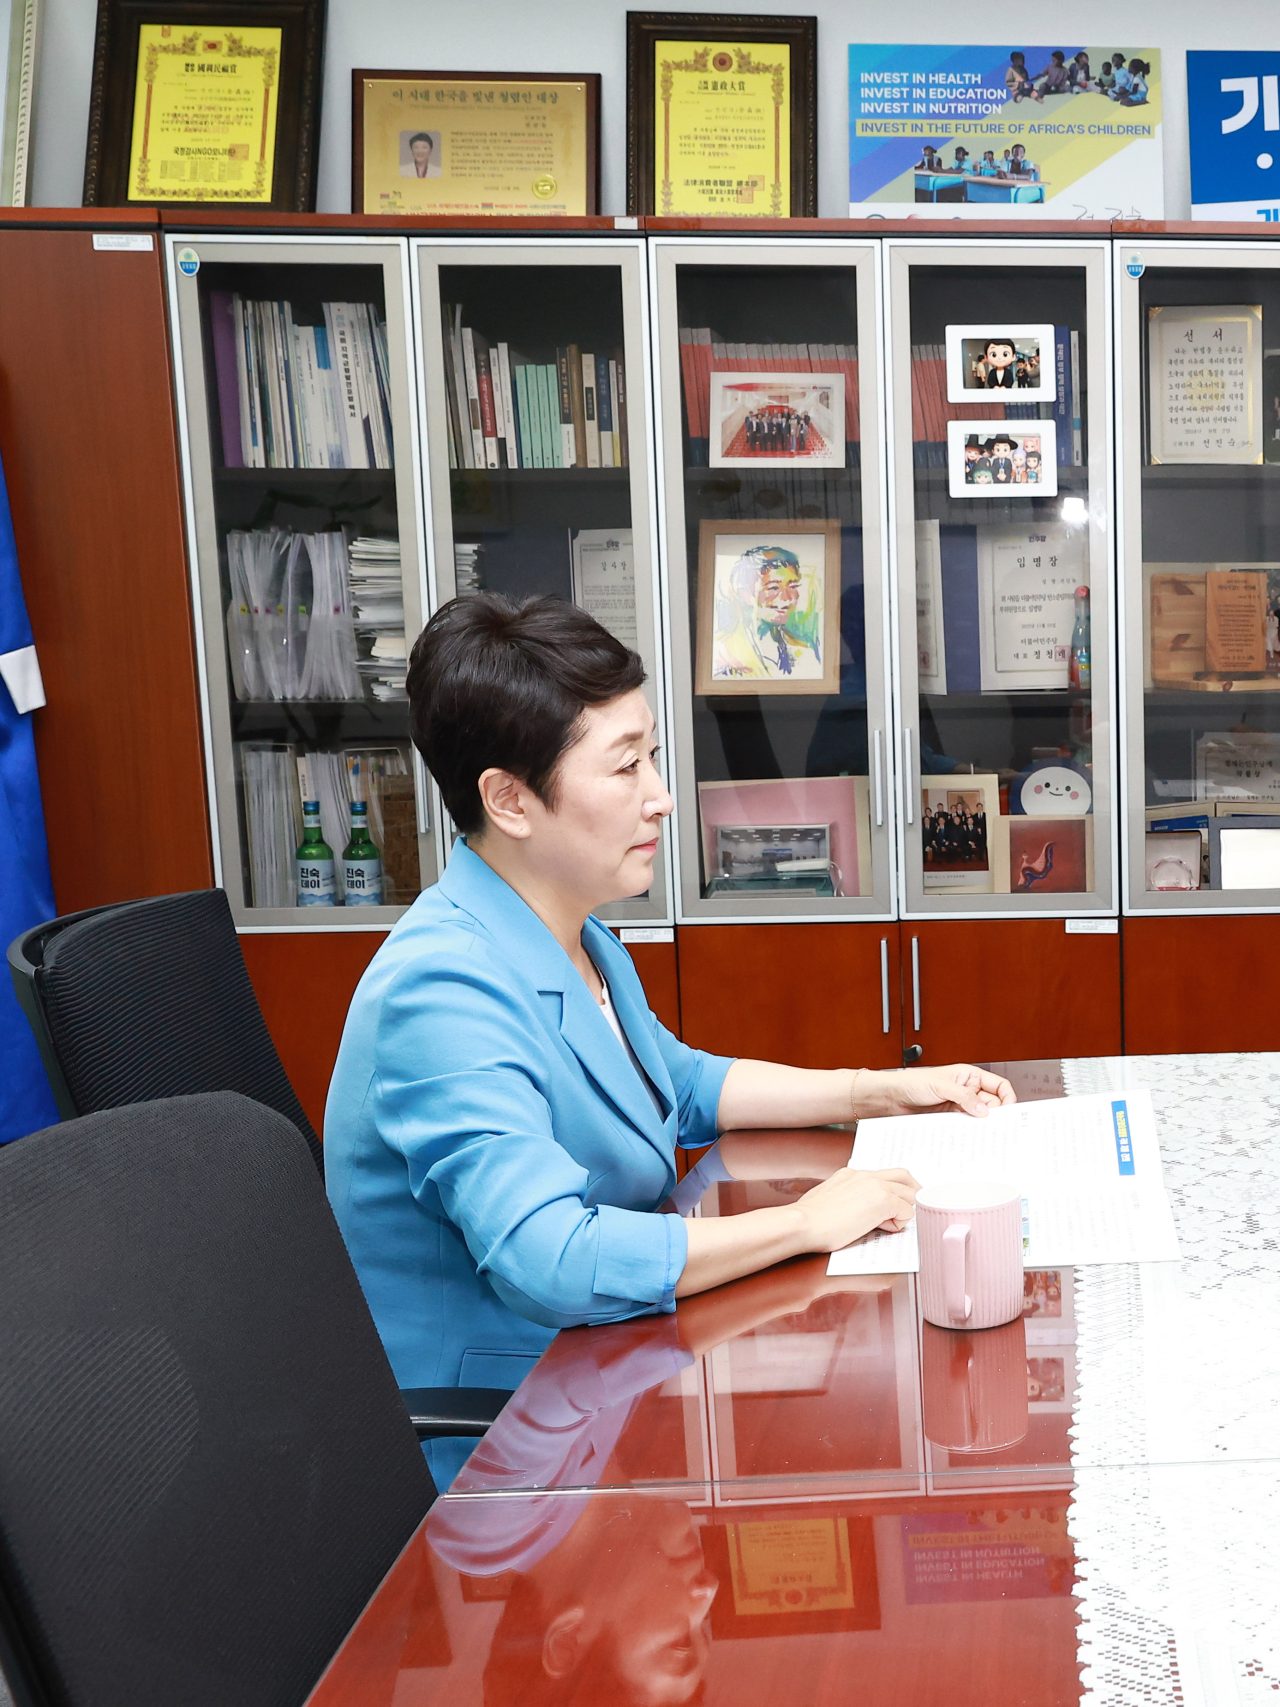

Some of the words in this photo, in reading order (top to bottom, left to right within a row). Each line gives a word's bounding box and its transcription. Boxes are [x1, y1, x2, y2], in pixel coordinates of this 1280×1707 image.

[860, 72, 909, 84] INVEST
[912, 72, 925, 84] IN
[928, 73, 981, 85] HEALTH
[392, 89, 403, 101] 이
[410, 89, 432, 101] 시대
[860, 87, 909, 99] INVEST
[912, 88, 926, 99] IN
[928, 88, 1007, 100] EDUCATION
[860, 102, 910, 114] INVEST
[912, 102, 926, 114] IN
[929, 103, 1002, 115] NUTRITION
[860, 122, 907, 133] INVEST
[910, 122, 923, 133] IN
[926, 122, 952, 134] THE
[954, 122, 1005, 134] FUTURE
[1008, 123, 1025, 134] OF
[1087, 123, 1151, 135] CHILDREN
[300, 867, 320, 879] 진숙
[346, 867, 365, 879] 진숙
